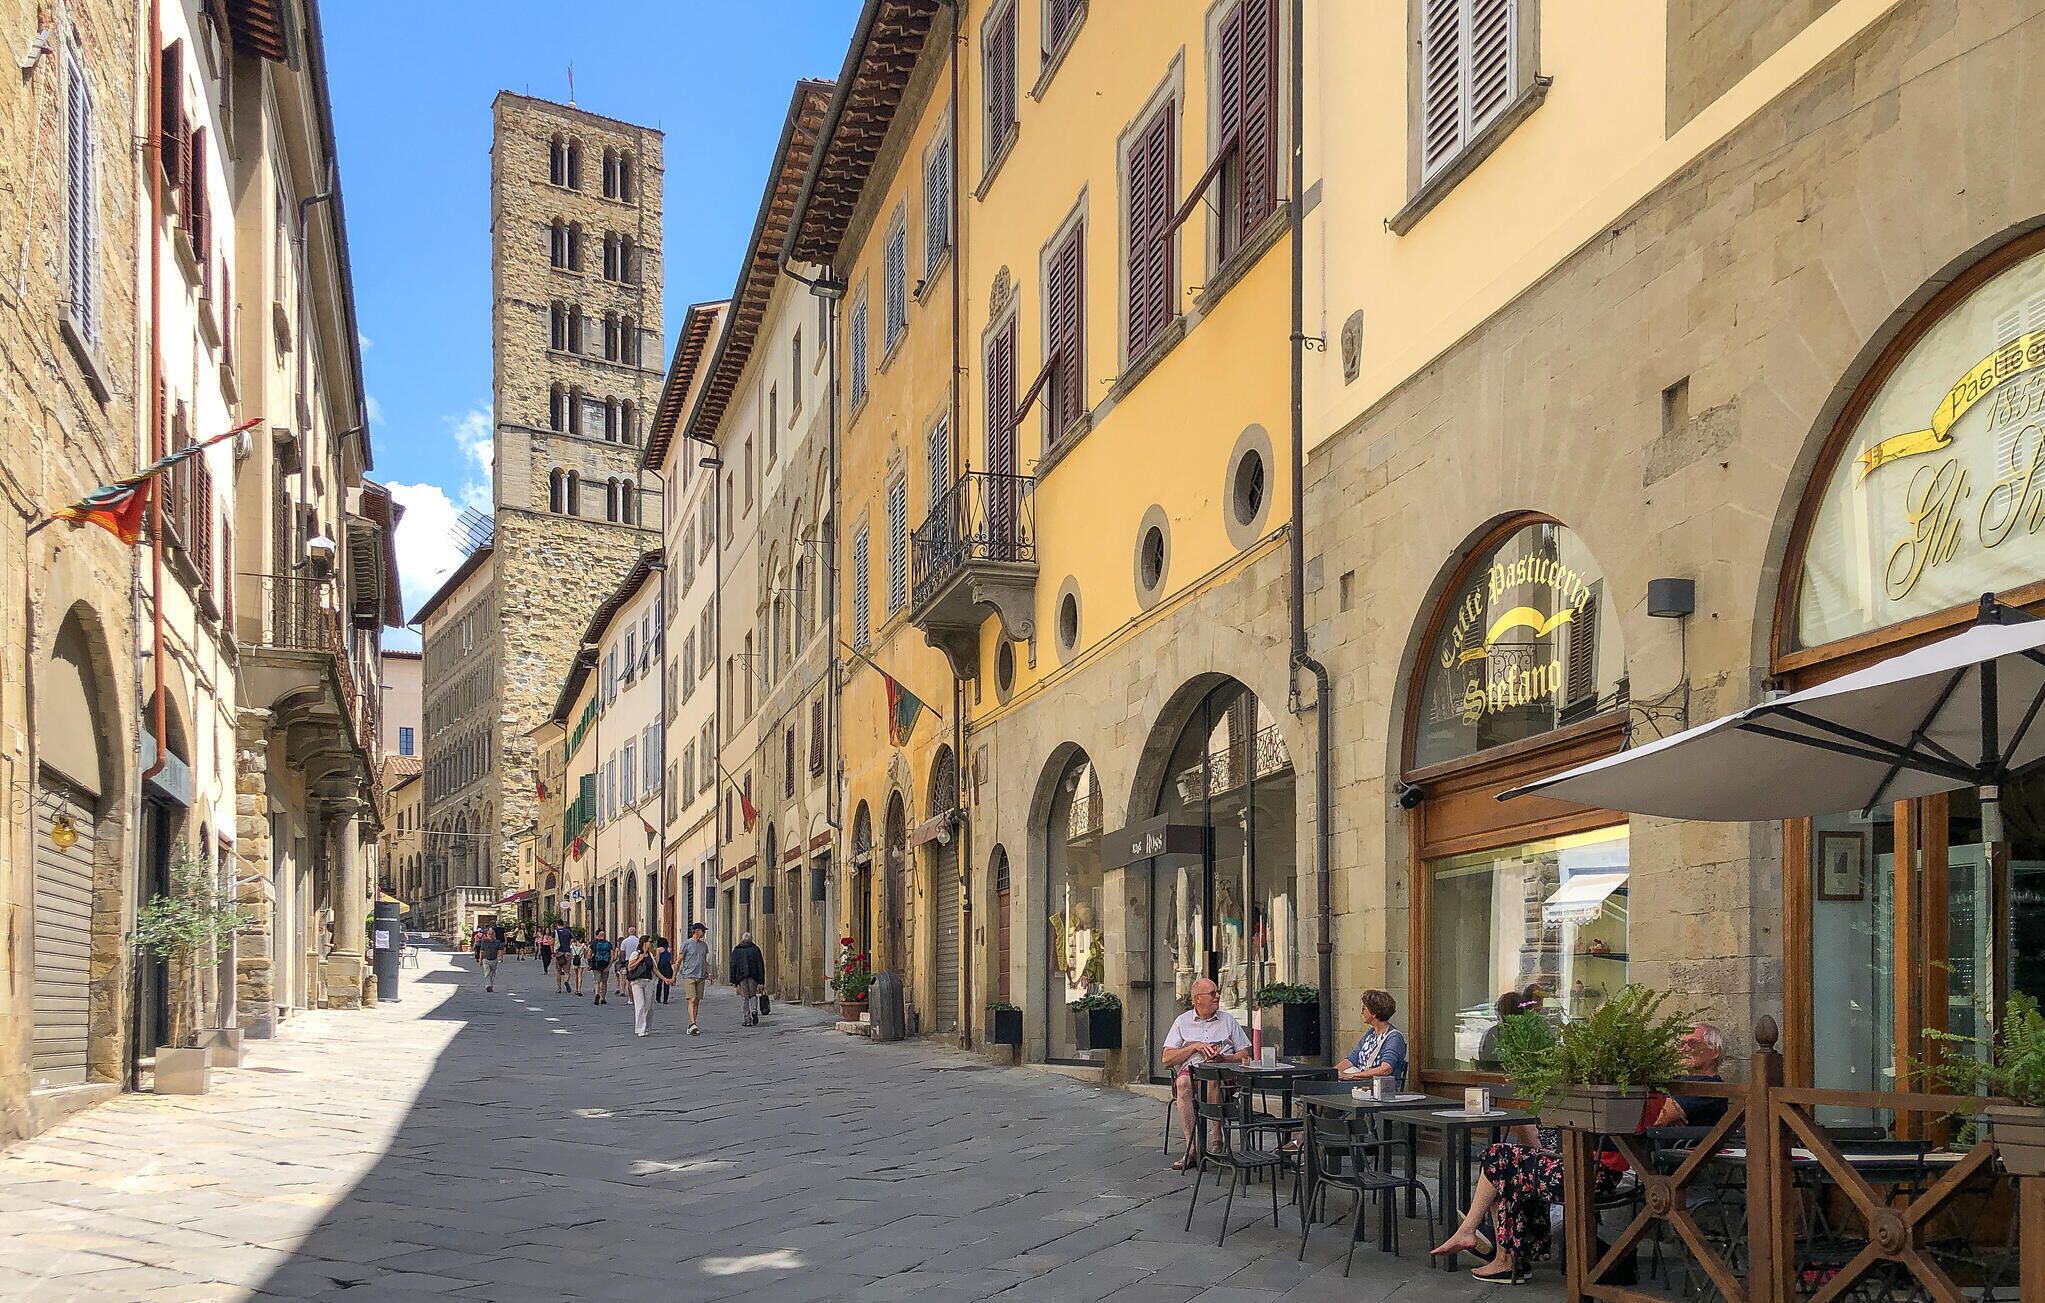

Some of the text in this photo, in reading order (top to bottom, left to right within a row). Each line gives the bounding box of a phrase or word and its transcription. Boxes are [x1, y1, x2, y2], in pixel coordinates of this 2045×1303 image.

[1951, 343, 2045, 420] Pasticc
[1885, 458, 1971, 601] Gli
[1487, 549, 1591, 614] Pasticceria
[1462, 659, 1561, 726] Stefano
